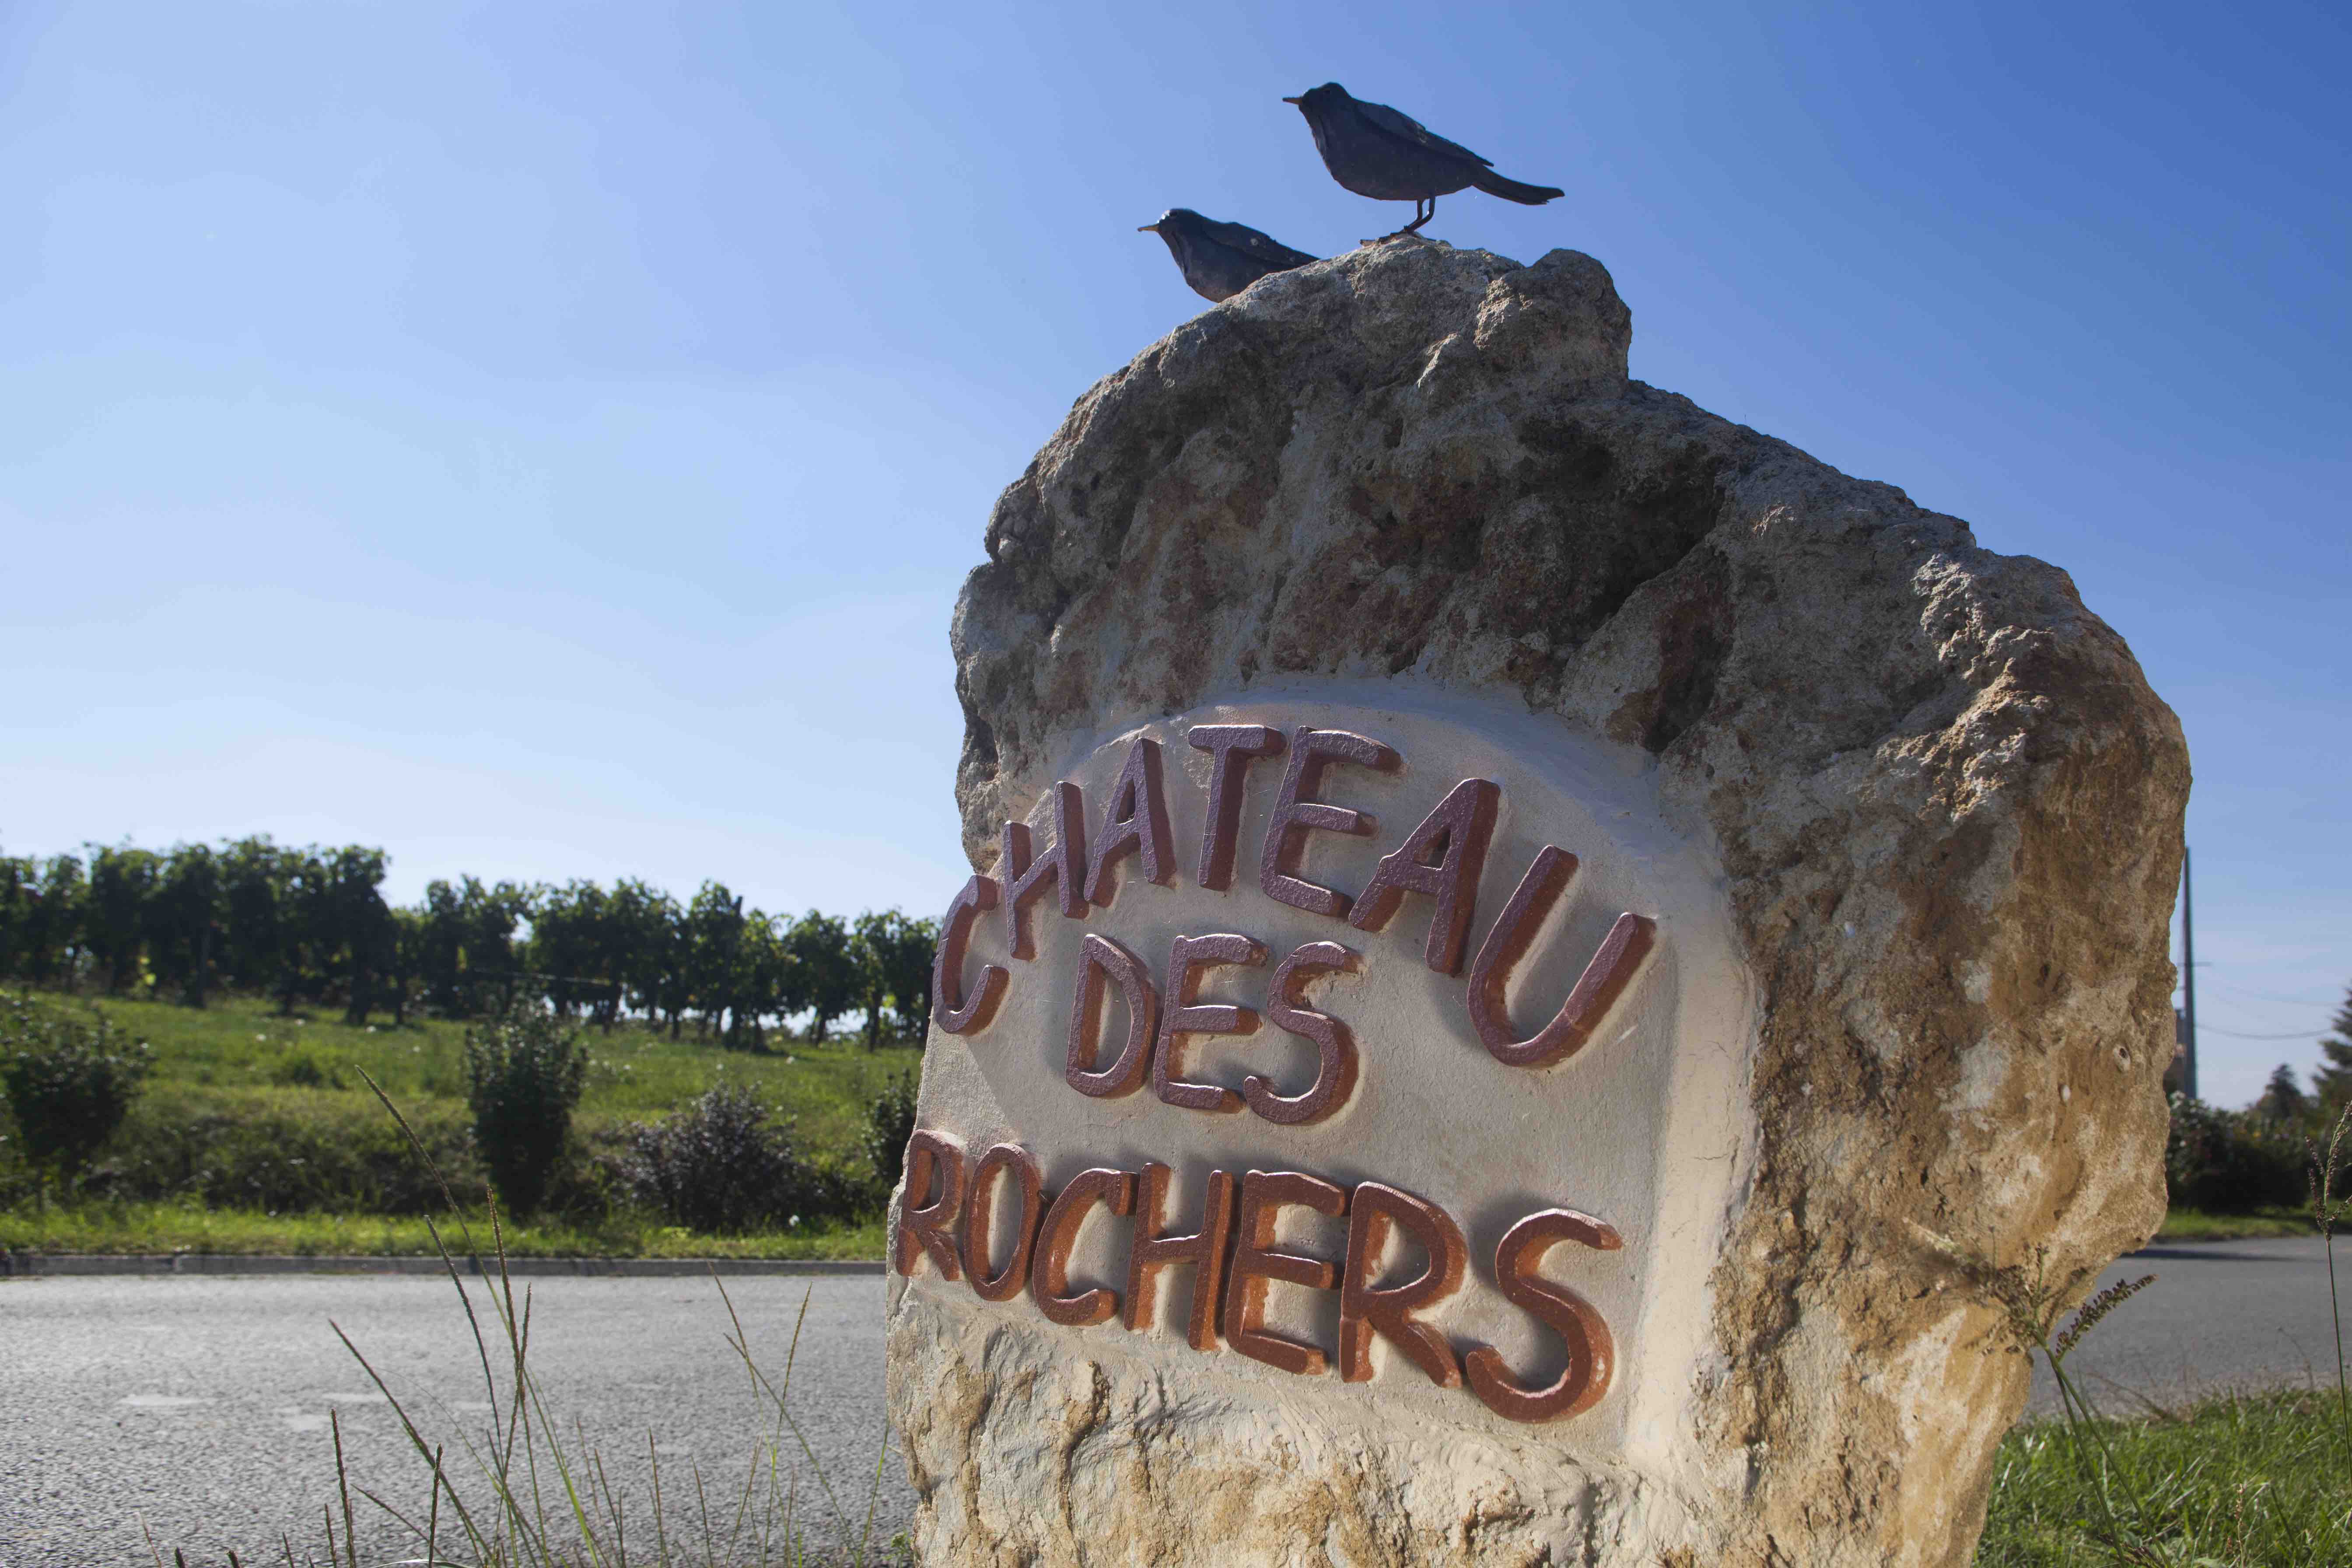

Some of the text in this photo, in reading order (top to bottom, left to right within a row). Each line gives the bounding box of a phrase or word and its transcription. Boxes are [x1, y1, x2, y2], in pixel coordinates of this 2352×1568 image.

[933, 724, 1656, 1070] CHATEAU
[1065, 934, 1362, 1126] DES
[896, 1129, 1623, 1423] ROCHERS
